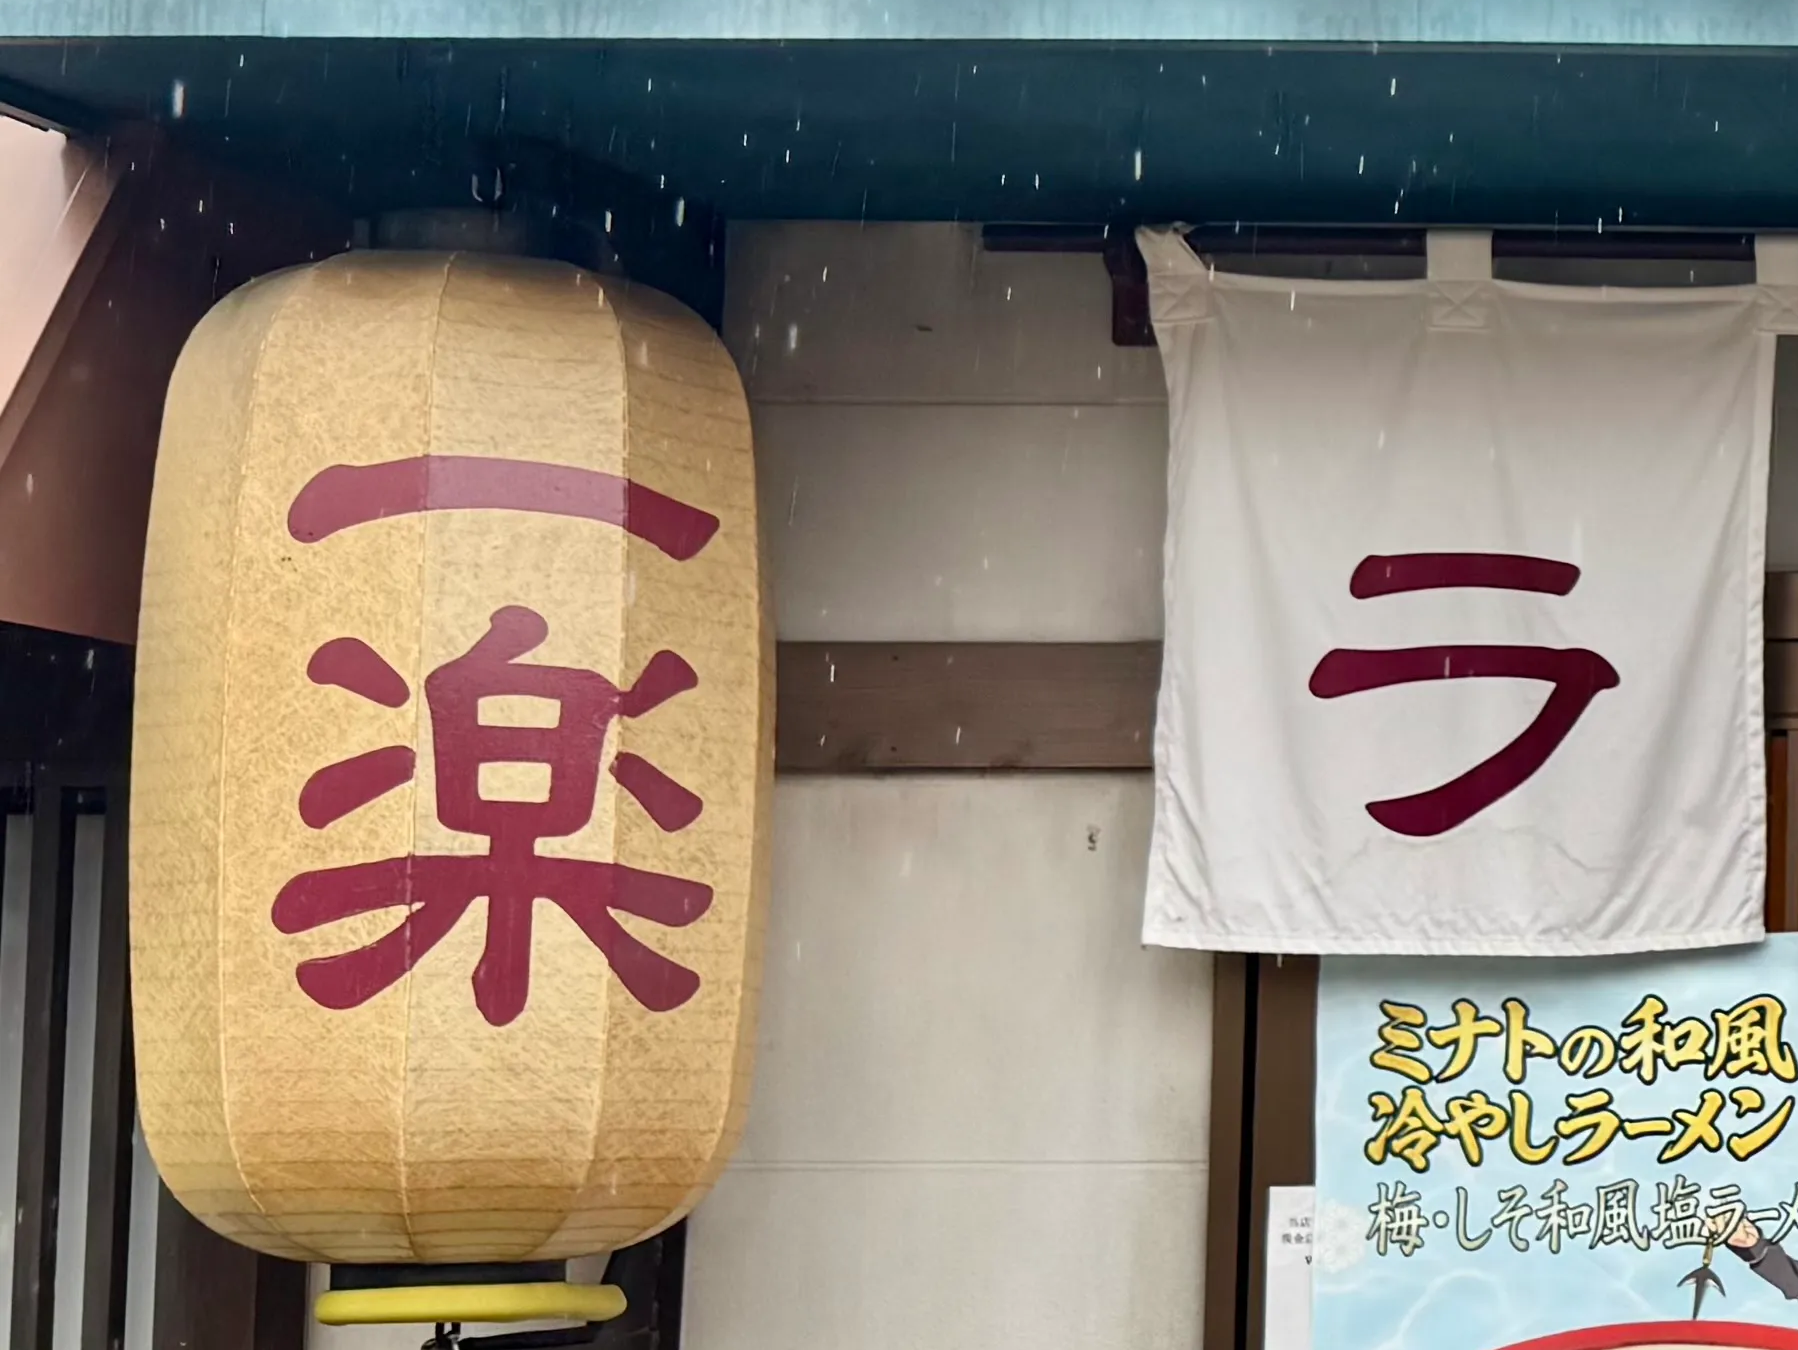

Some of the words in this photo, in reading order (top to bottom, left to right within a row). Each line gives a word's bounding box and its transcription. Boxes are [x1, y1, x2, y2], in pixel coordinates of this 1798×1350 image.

[271, 454, 720, 1027] 一楽
[1364, 1086, 1797, 1174] 冷やしラーメン
